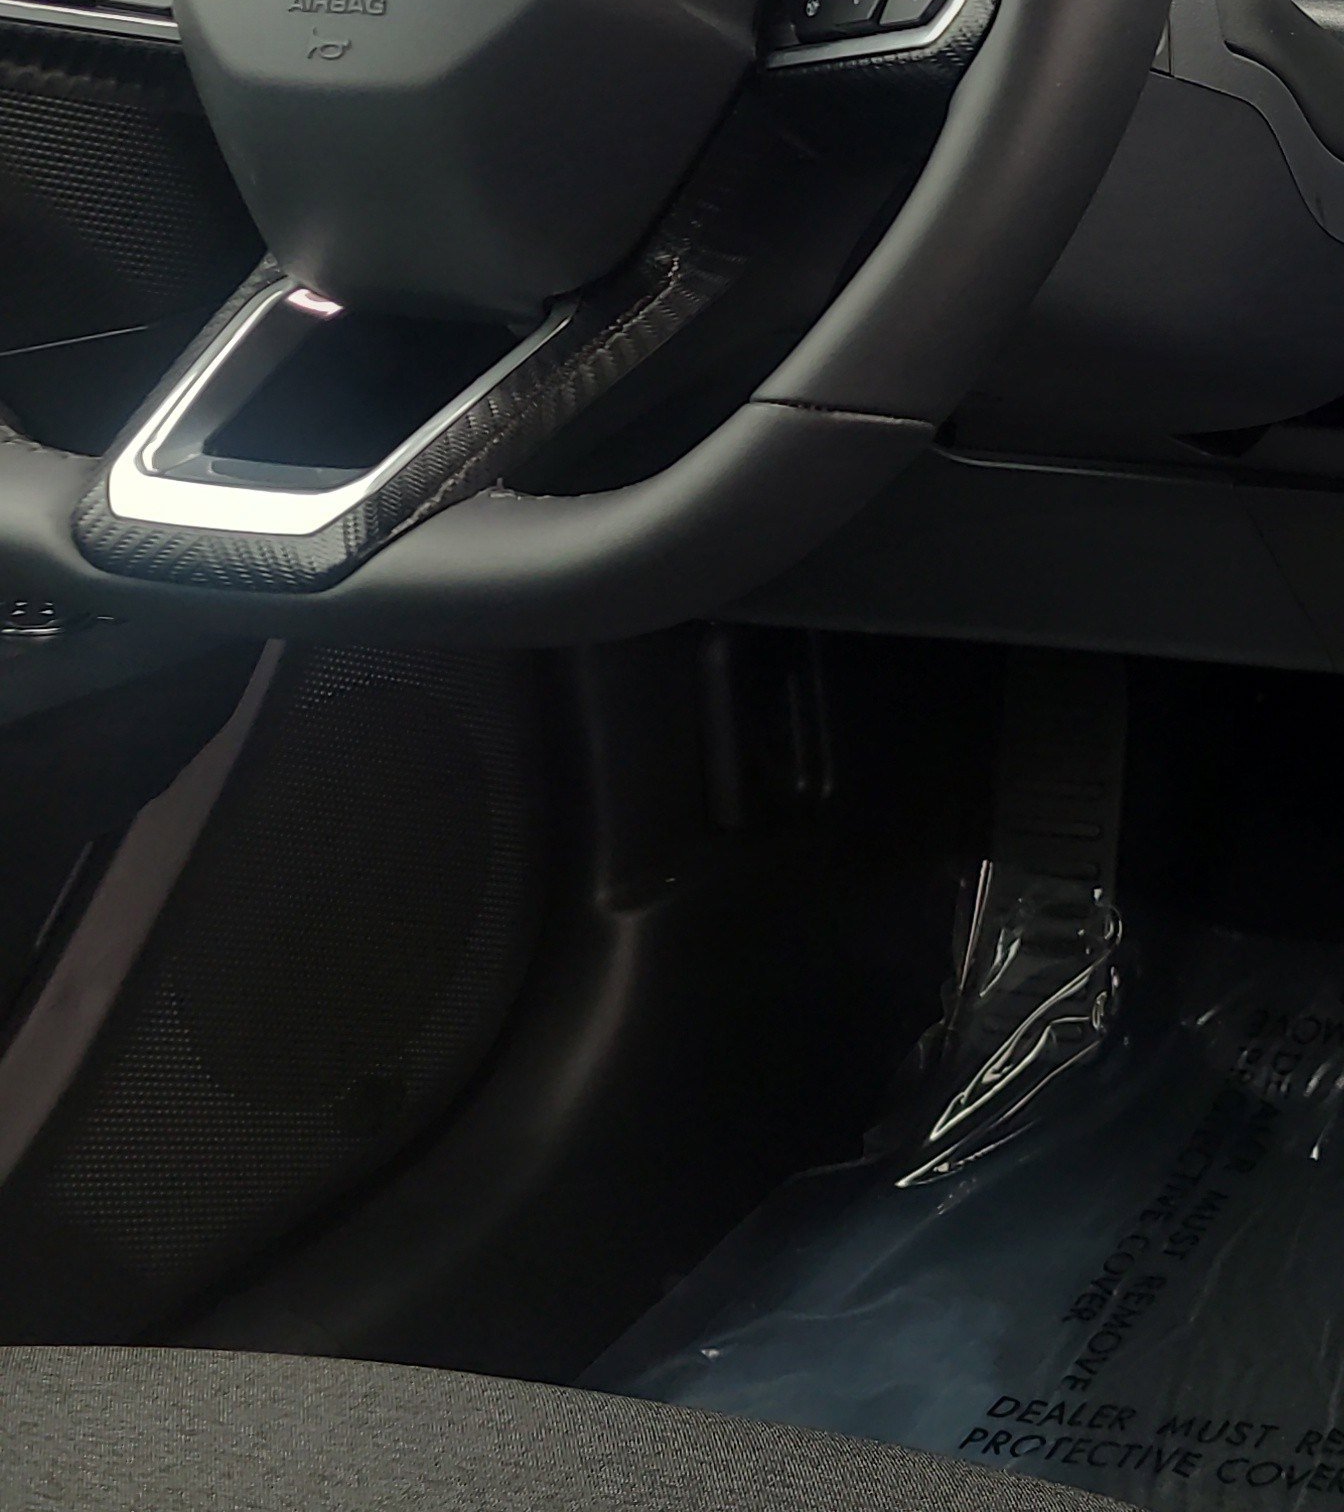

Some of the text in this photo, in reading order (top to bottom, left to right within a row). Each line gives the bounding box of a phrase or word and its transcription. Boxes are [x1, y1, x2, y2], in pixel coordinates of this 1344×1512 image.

[986, 1394, 1138, 1432] DEALER
[1156, 1415, 1280, 1449] MUST
[957, 1425, 1204, 1478] PROTECTIVE
